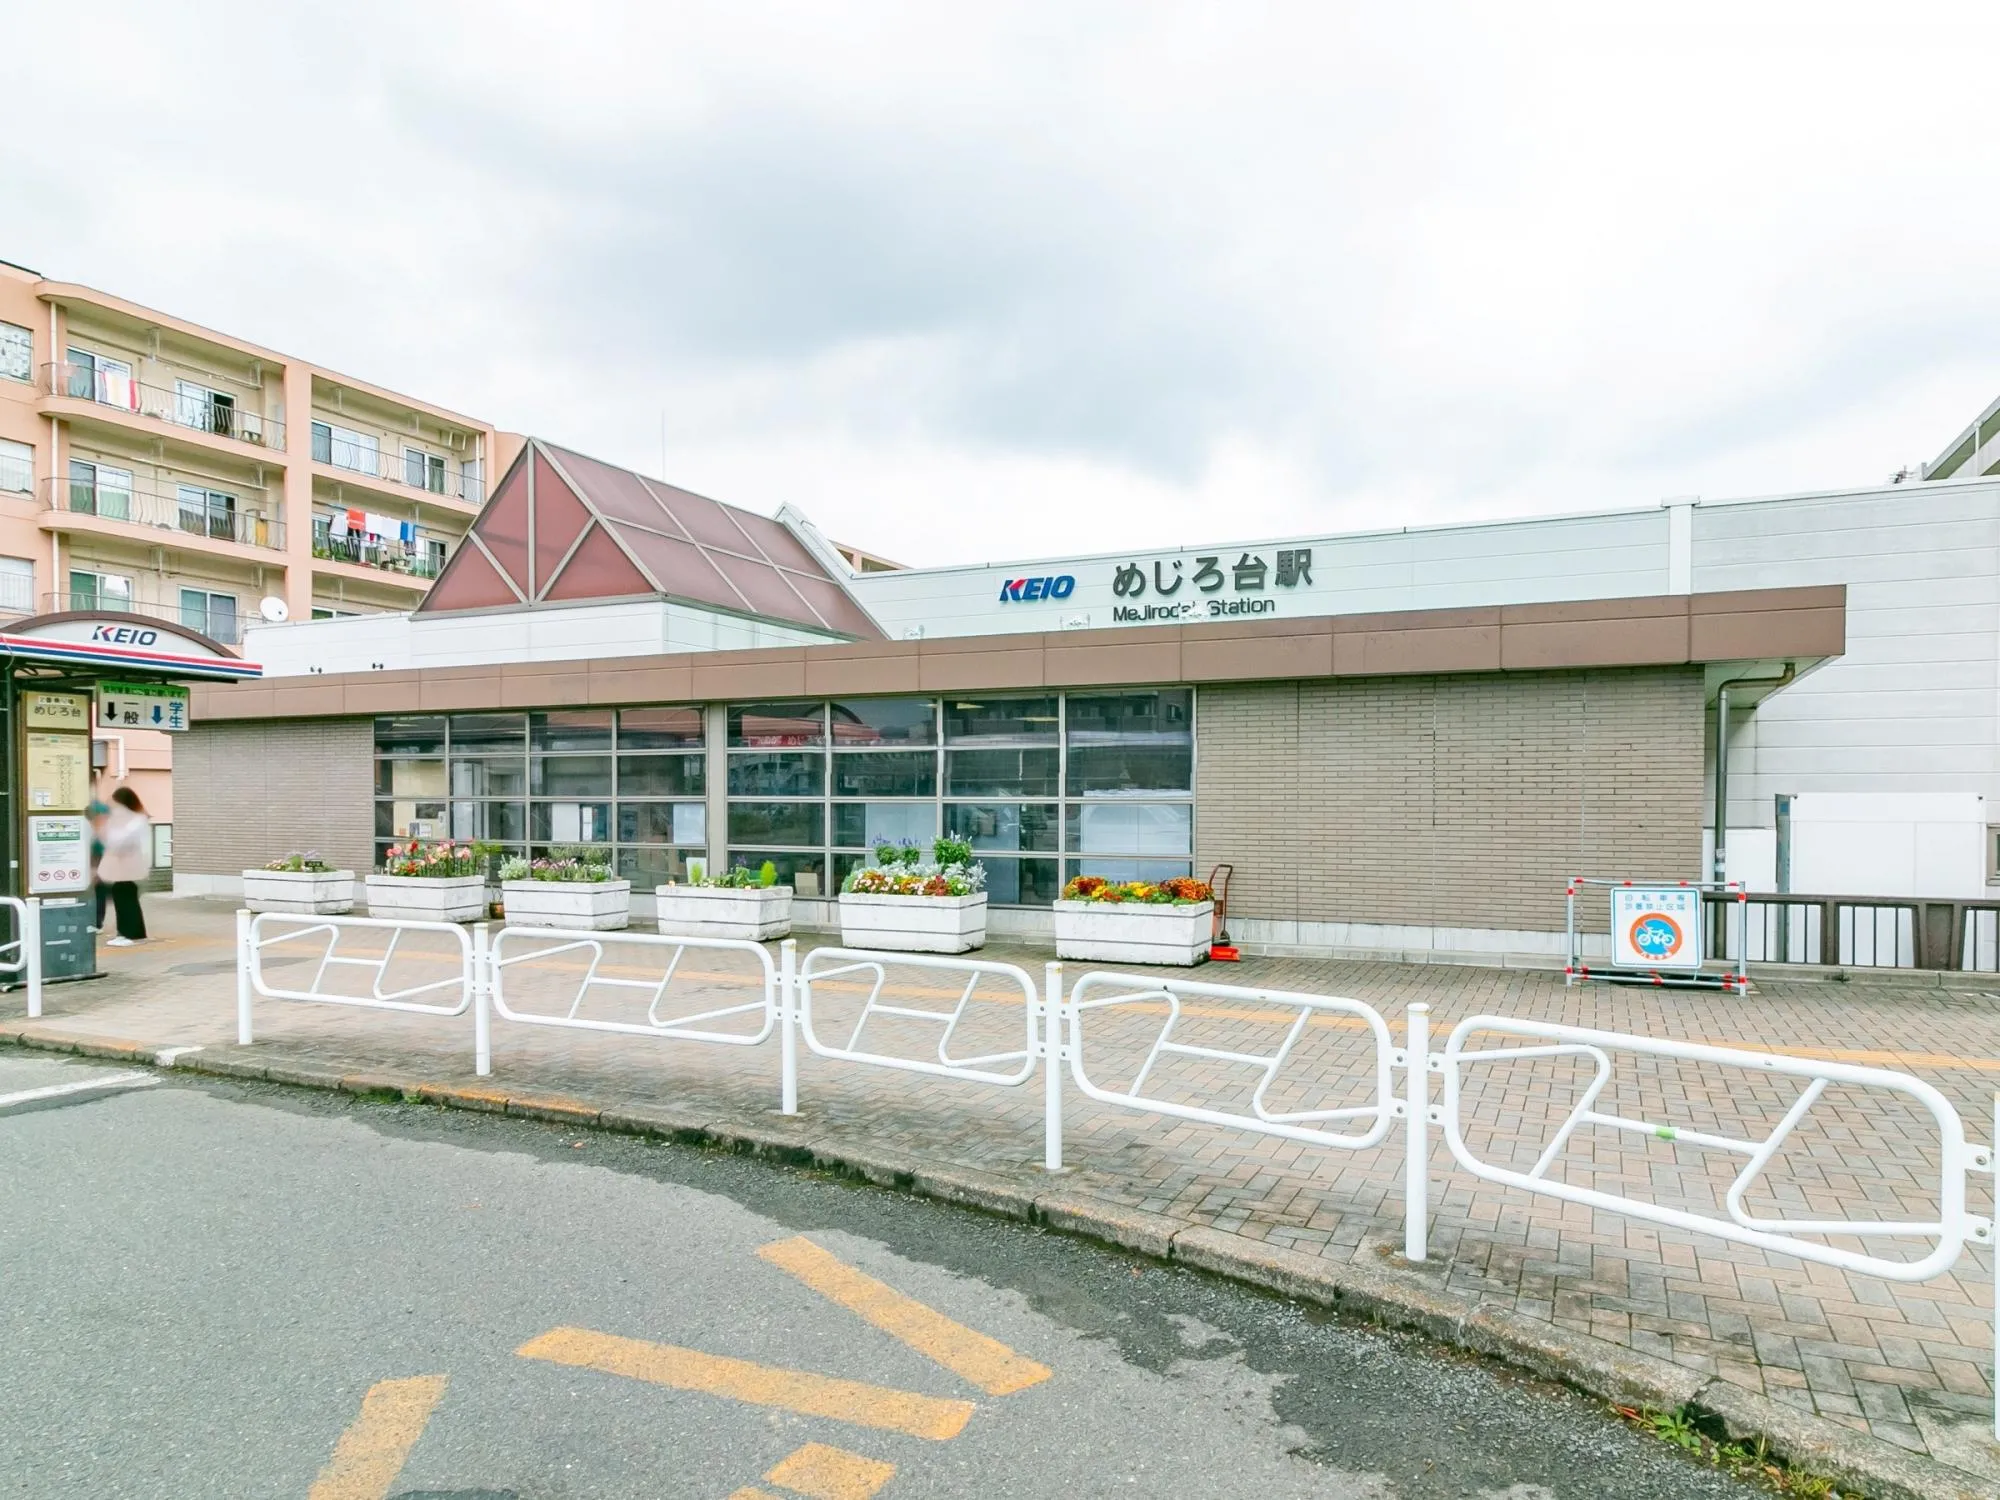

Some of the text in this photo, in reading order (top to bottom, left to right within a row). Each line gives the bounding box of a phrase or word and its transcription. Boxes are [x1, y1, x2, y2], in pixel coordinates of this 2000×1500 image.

[1113, 549, 1312, 597] めじろ台駅
[999, 575, 1075, 601] KEIO
[1113, 597, 1275, 622] Mejiroda Station
[92, 626, 157, 645] KEIO
[34, 706, 81, 718] めじろ台
[124, 702, 139, 724] 一般
[169, 701, 183, 728] 学生
